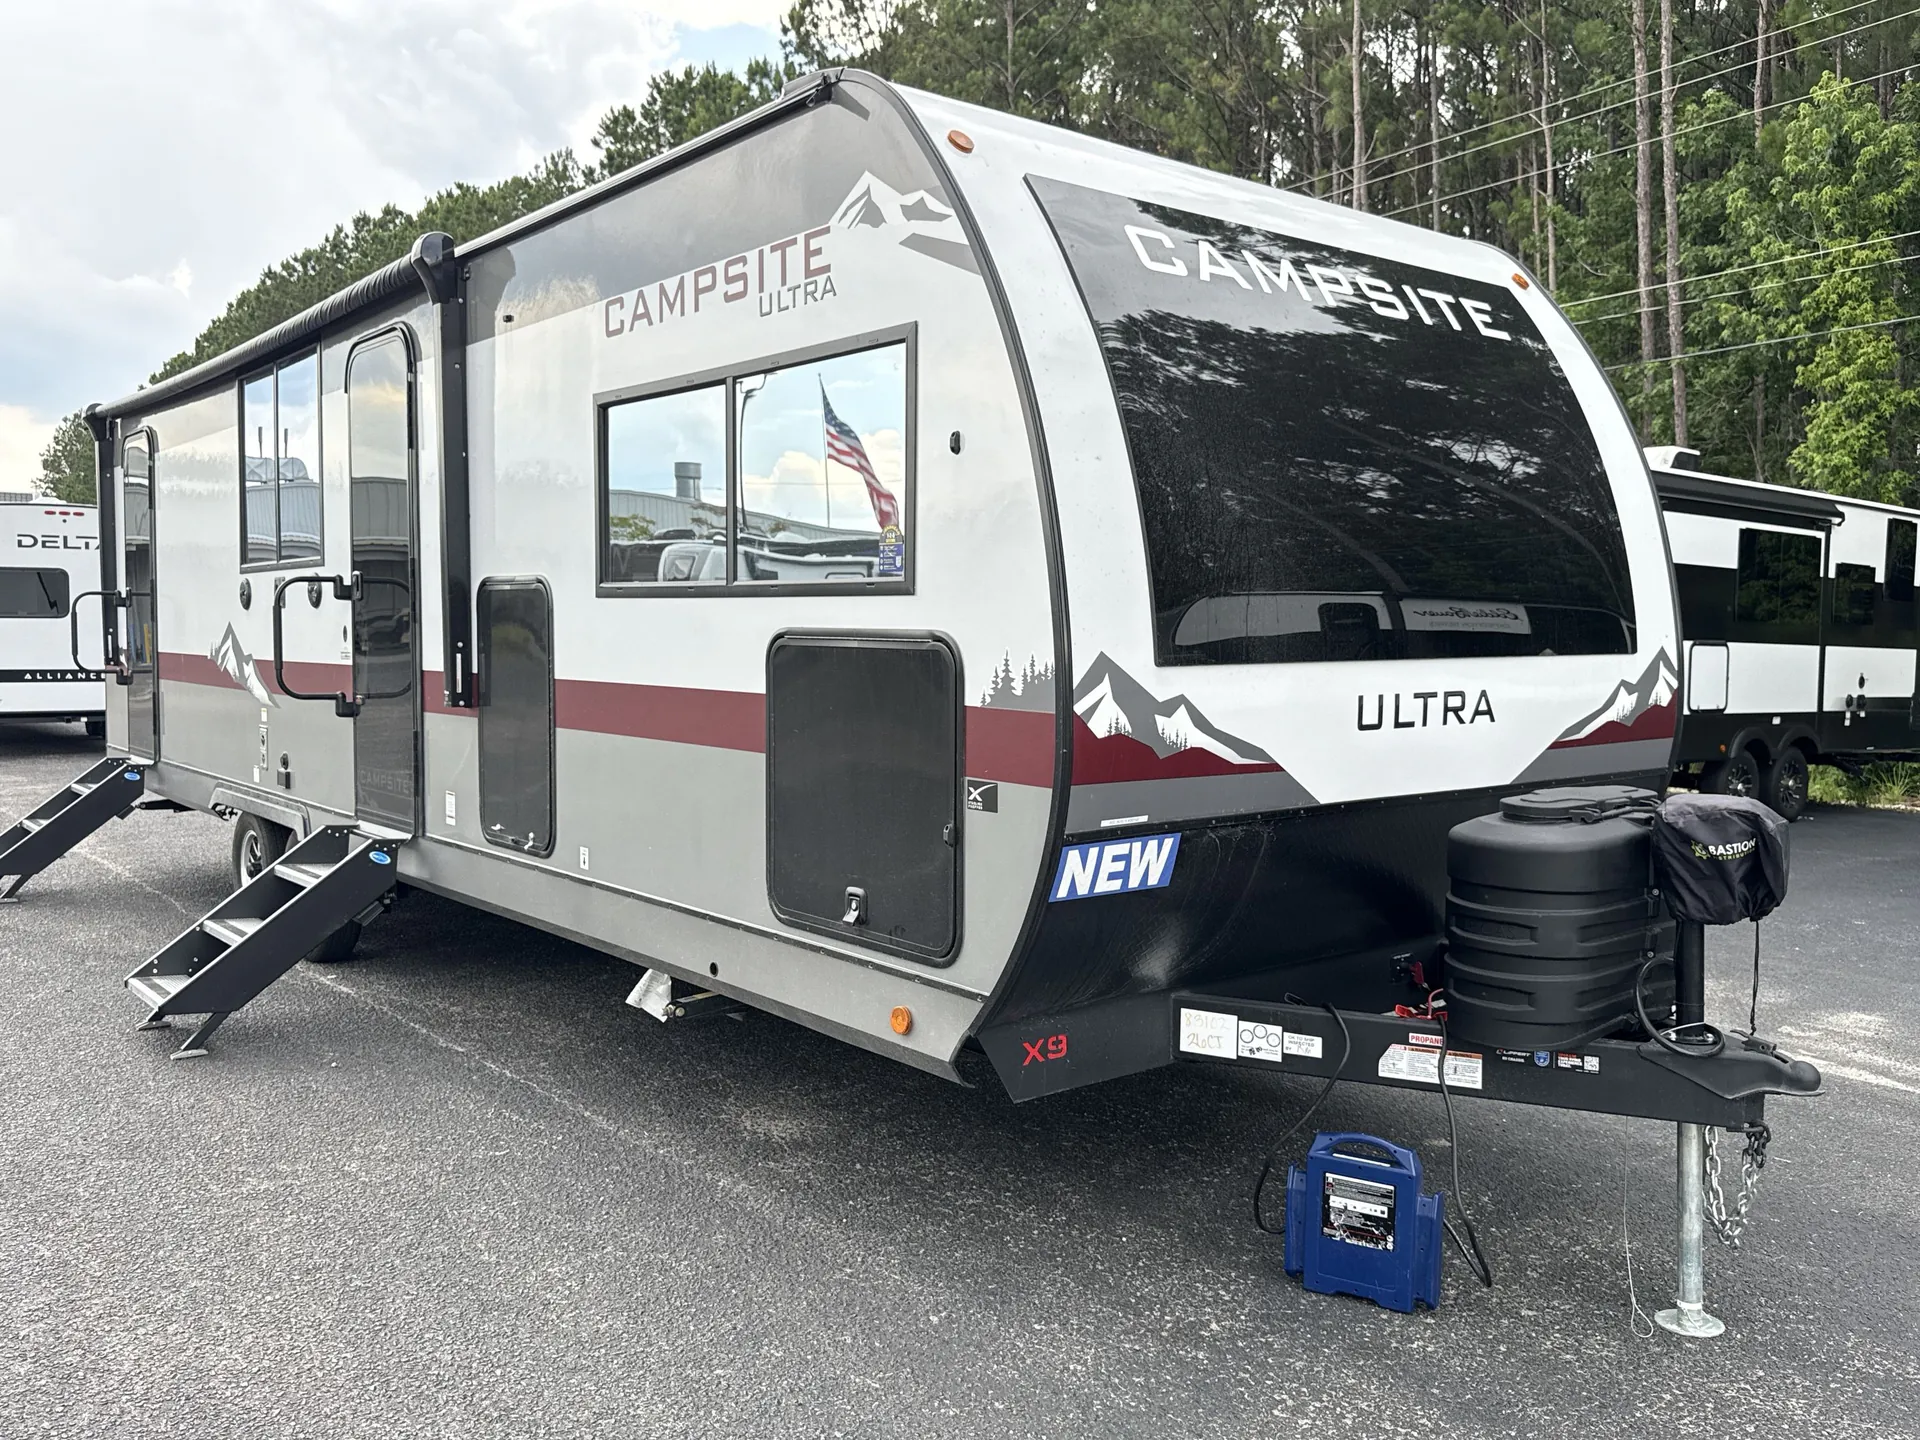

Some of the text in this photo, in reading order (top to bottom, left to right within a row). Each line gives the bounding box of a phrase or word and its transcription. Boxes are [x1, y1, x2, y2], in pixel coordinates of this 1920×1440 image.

[604, 225, 832, 338] CAMPSITE
[759, 275, 837, 318] ULTRA
[1123, 223, 1512, 342] CAMPSITE
[16, 533, 100, 551] DELT
[1357, 689, 1496, 732] ULTRA
[1055, 837, 1175, 899] NEW
[1708, 837, 1757, 856] BASTION
[1022, 1034, 1069, 1067] X9
[1410, 1034, 1444, 1046] PROPANE
